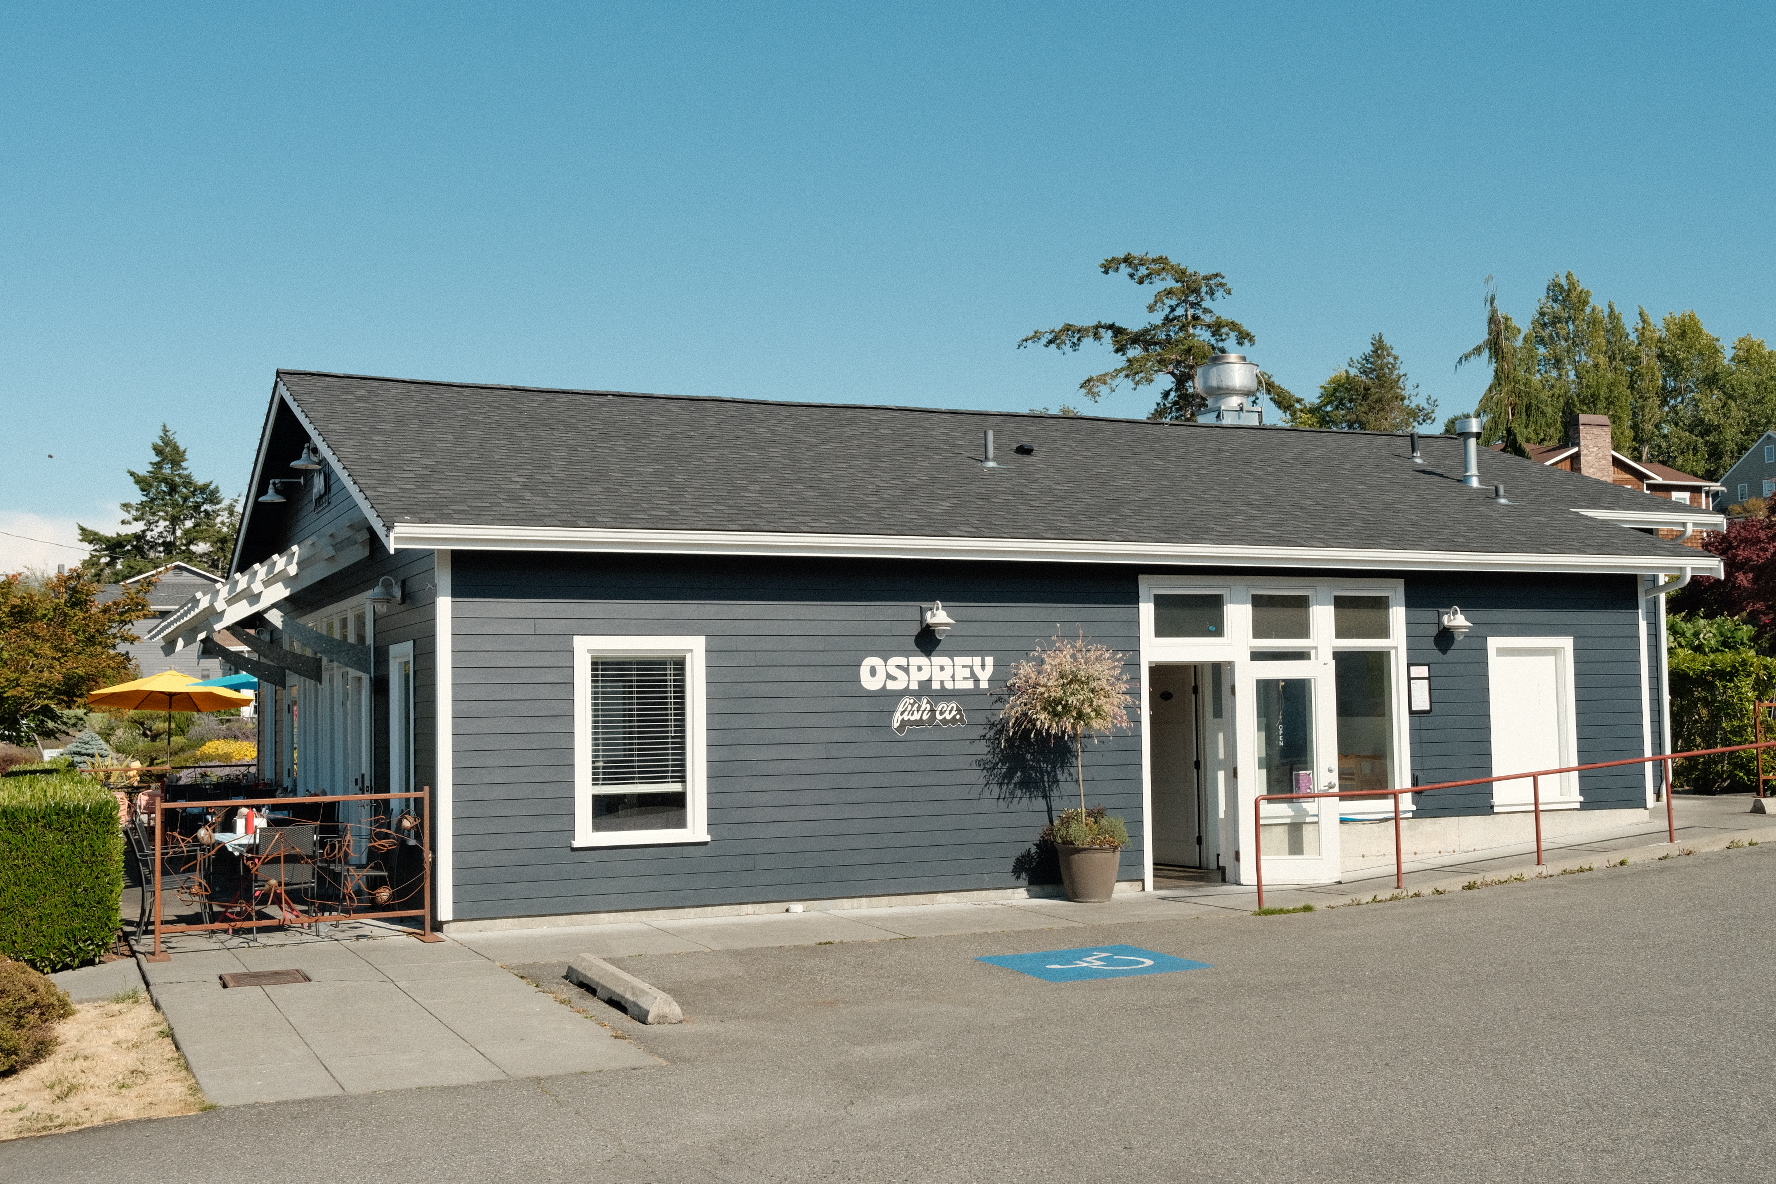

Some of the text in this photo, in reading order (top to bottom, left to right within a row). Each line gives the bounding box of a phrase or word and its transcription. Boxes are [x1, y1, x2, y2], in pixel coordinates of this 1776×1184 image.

[860, 656, 994, 690] OSPREY
[893, 697, 961, 729] fish co.
